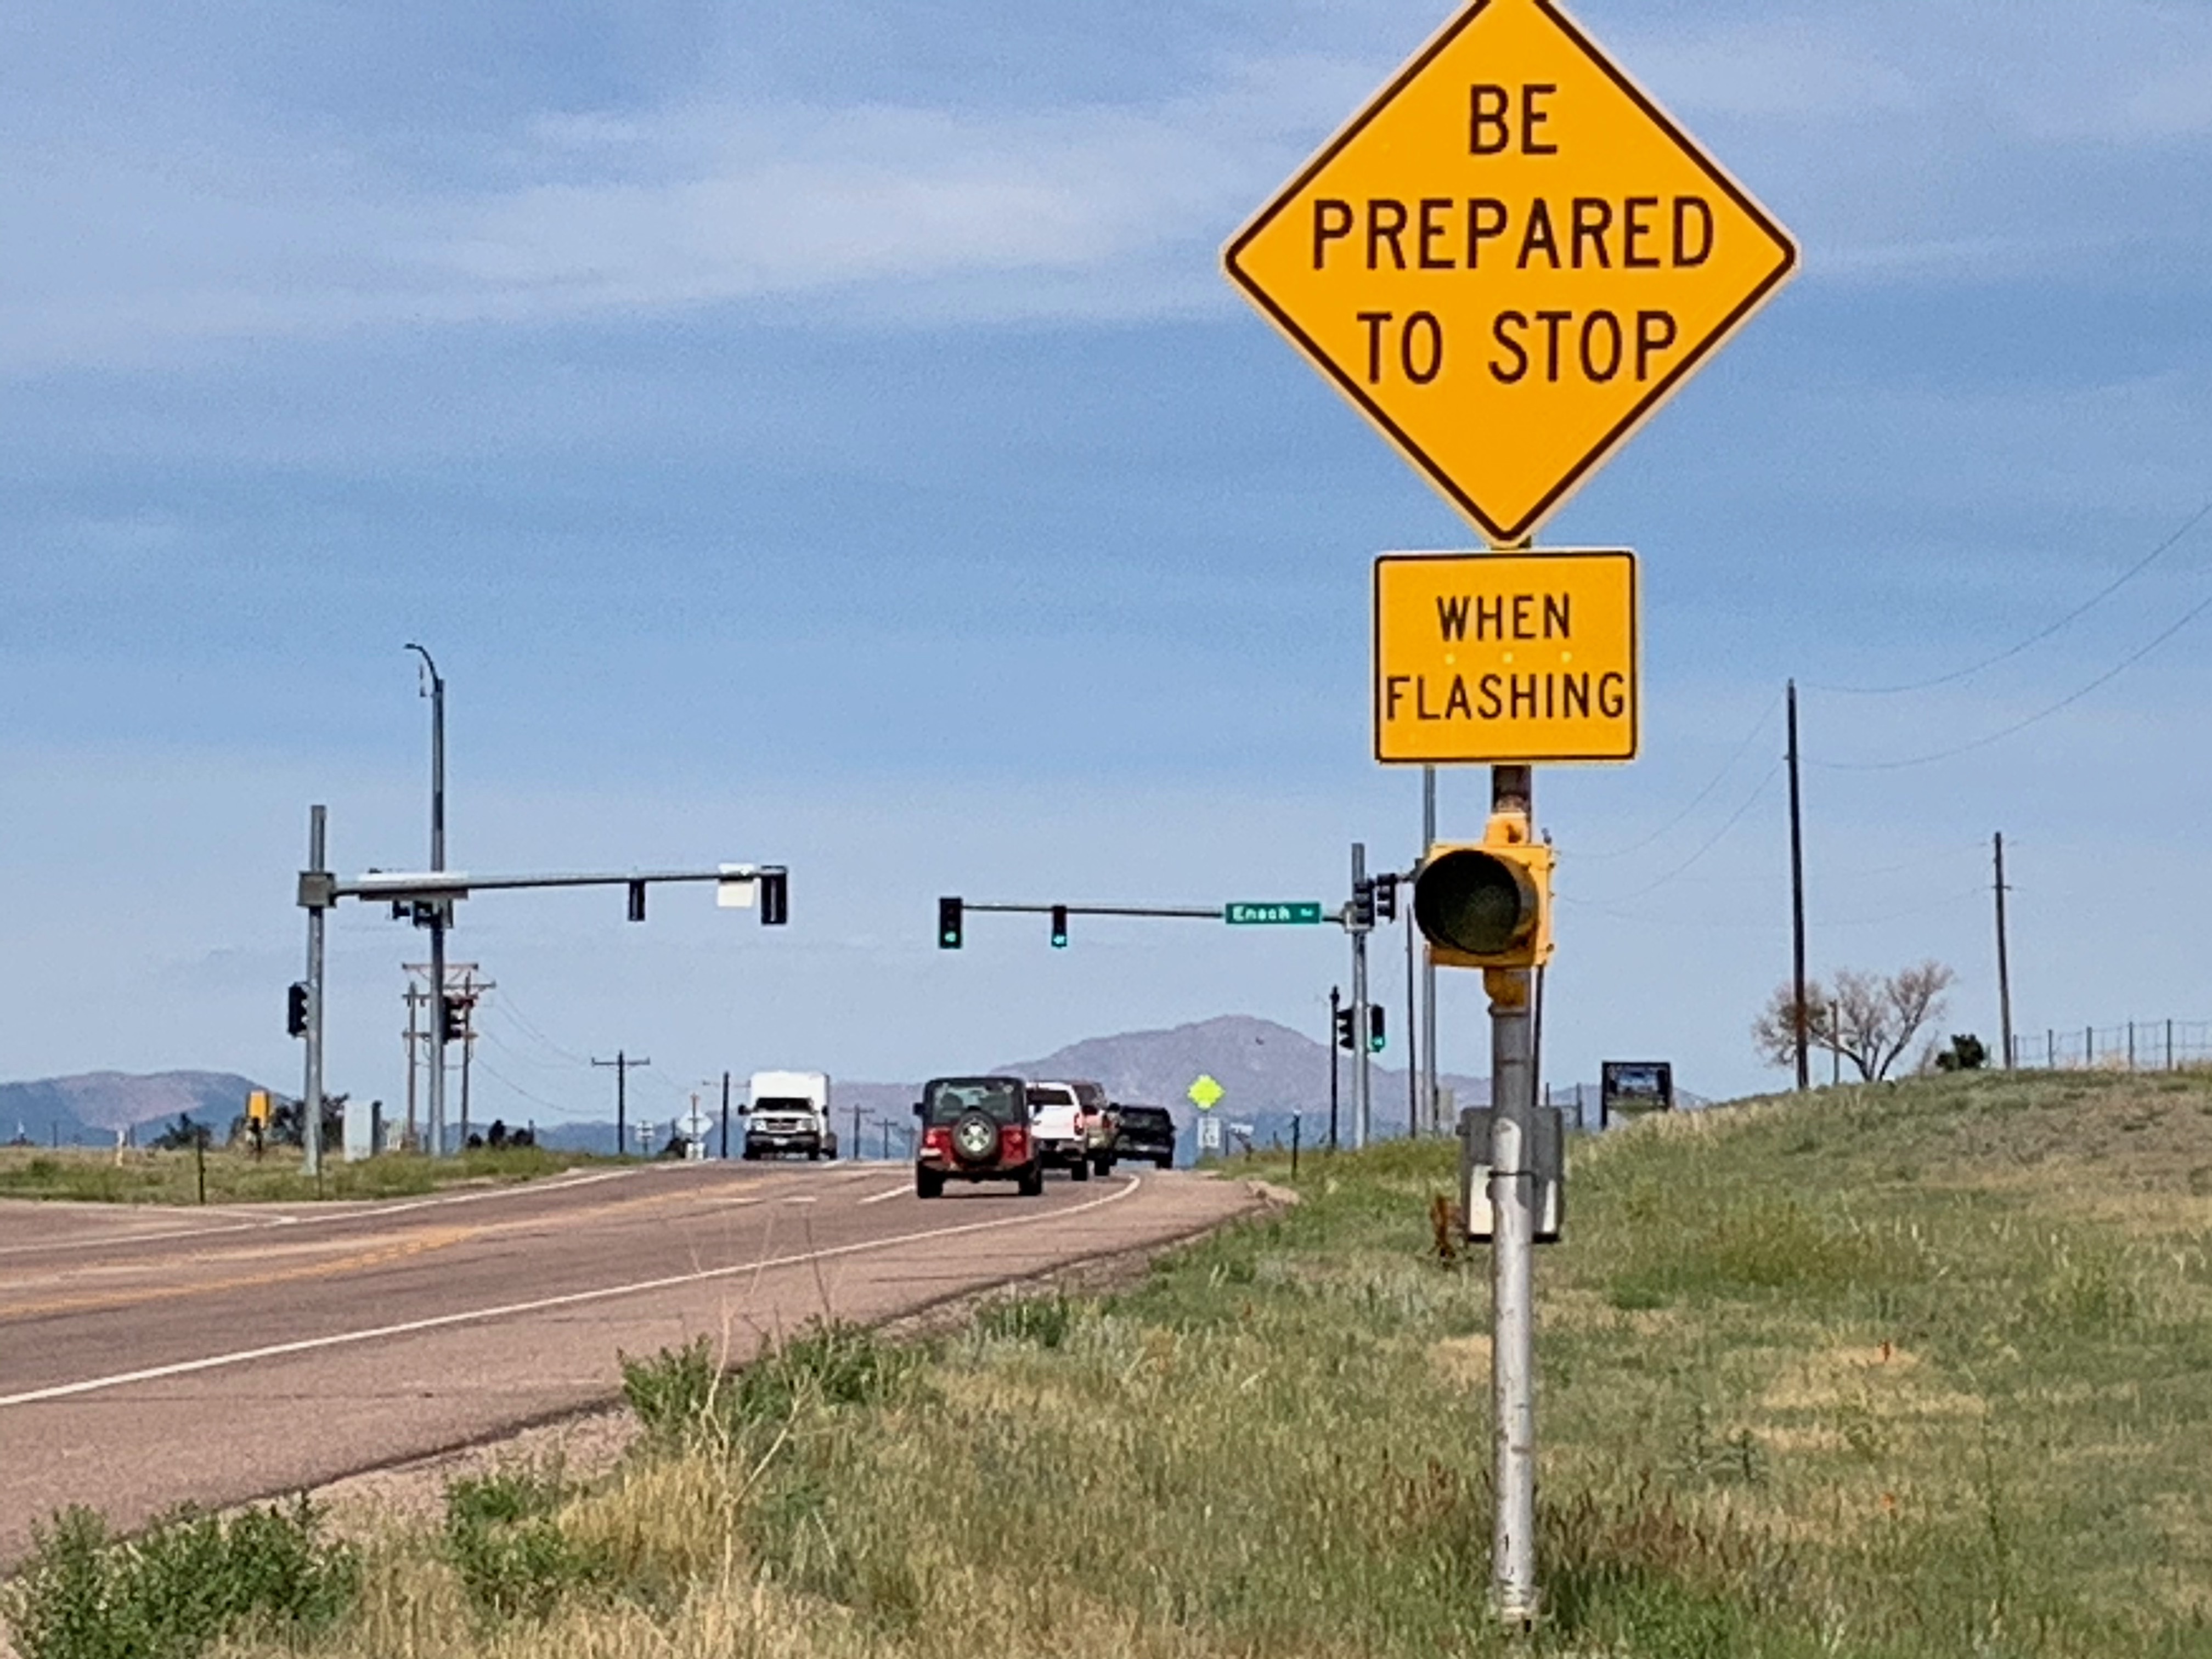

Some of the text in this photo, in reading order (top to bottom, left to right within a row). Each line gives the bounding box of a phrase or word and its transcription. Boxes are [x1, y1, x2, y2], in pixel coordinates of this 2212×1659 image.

[1470, 84, 1558, 155] BE
[1313, 196, 1714, 270] PREPARED
[1356, 310, 1677, 385] TO STOP
[1437, 593, 1570, 641] WHEN
[1386, 672, 1624, 720] FLASHING
